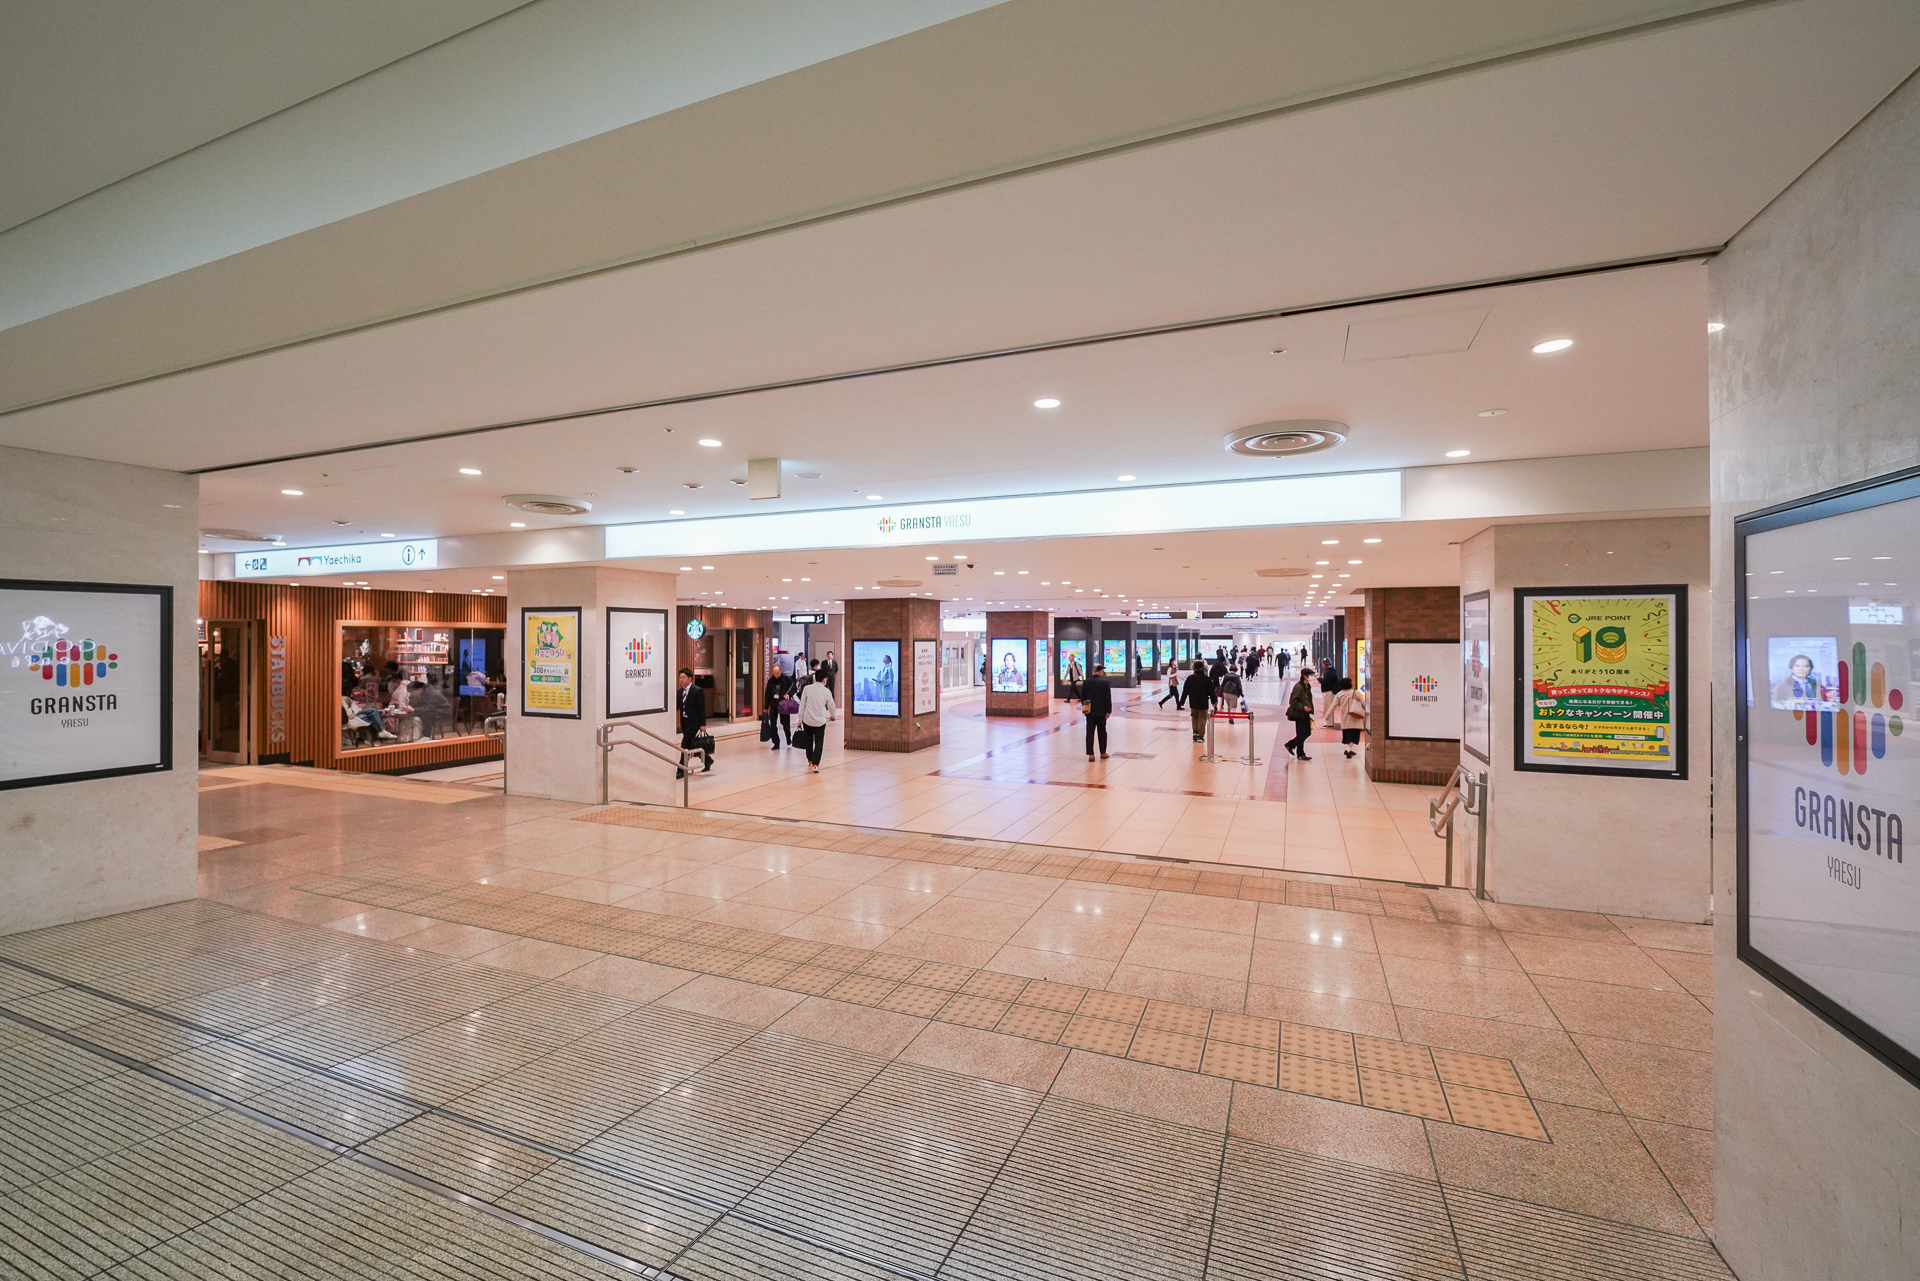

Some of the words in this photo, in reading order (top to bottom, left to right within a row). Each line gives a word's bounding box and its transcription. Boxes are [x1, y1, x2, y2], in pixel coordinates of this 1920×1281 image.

[900, 515, 942, 530] GRANSTA
[943, 513, 971, 528] YAESU
[323, 553, 362, 566] Yaechika
[1573, 626, 1627, 664] 10
[625, 668, 652, 679] GRANSTA
[270, 635, 286, 744] STARBUCKS
[30, 694, 117, 715] GRANSTA
[1538, 708, 1664, 720] おトクなキャンペーン開催中
[61, 718, 89, 728] YAESU
[1795, 786, 1903, 864] GRANSTA
[1827, 855, 1861, 890] YAESU
